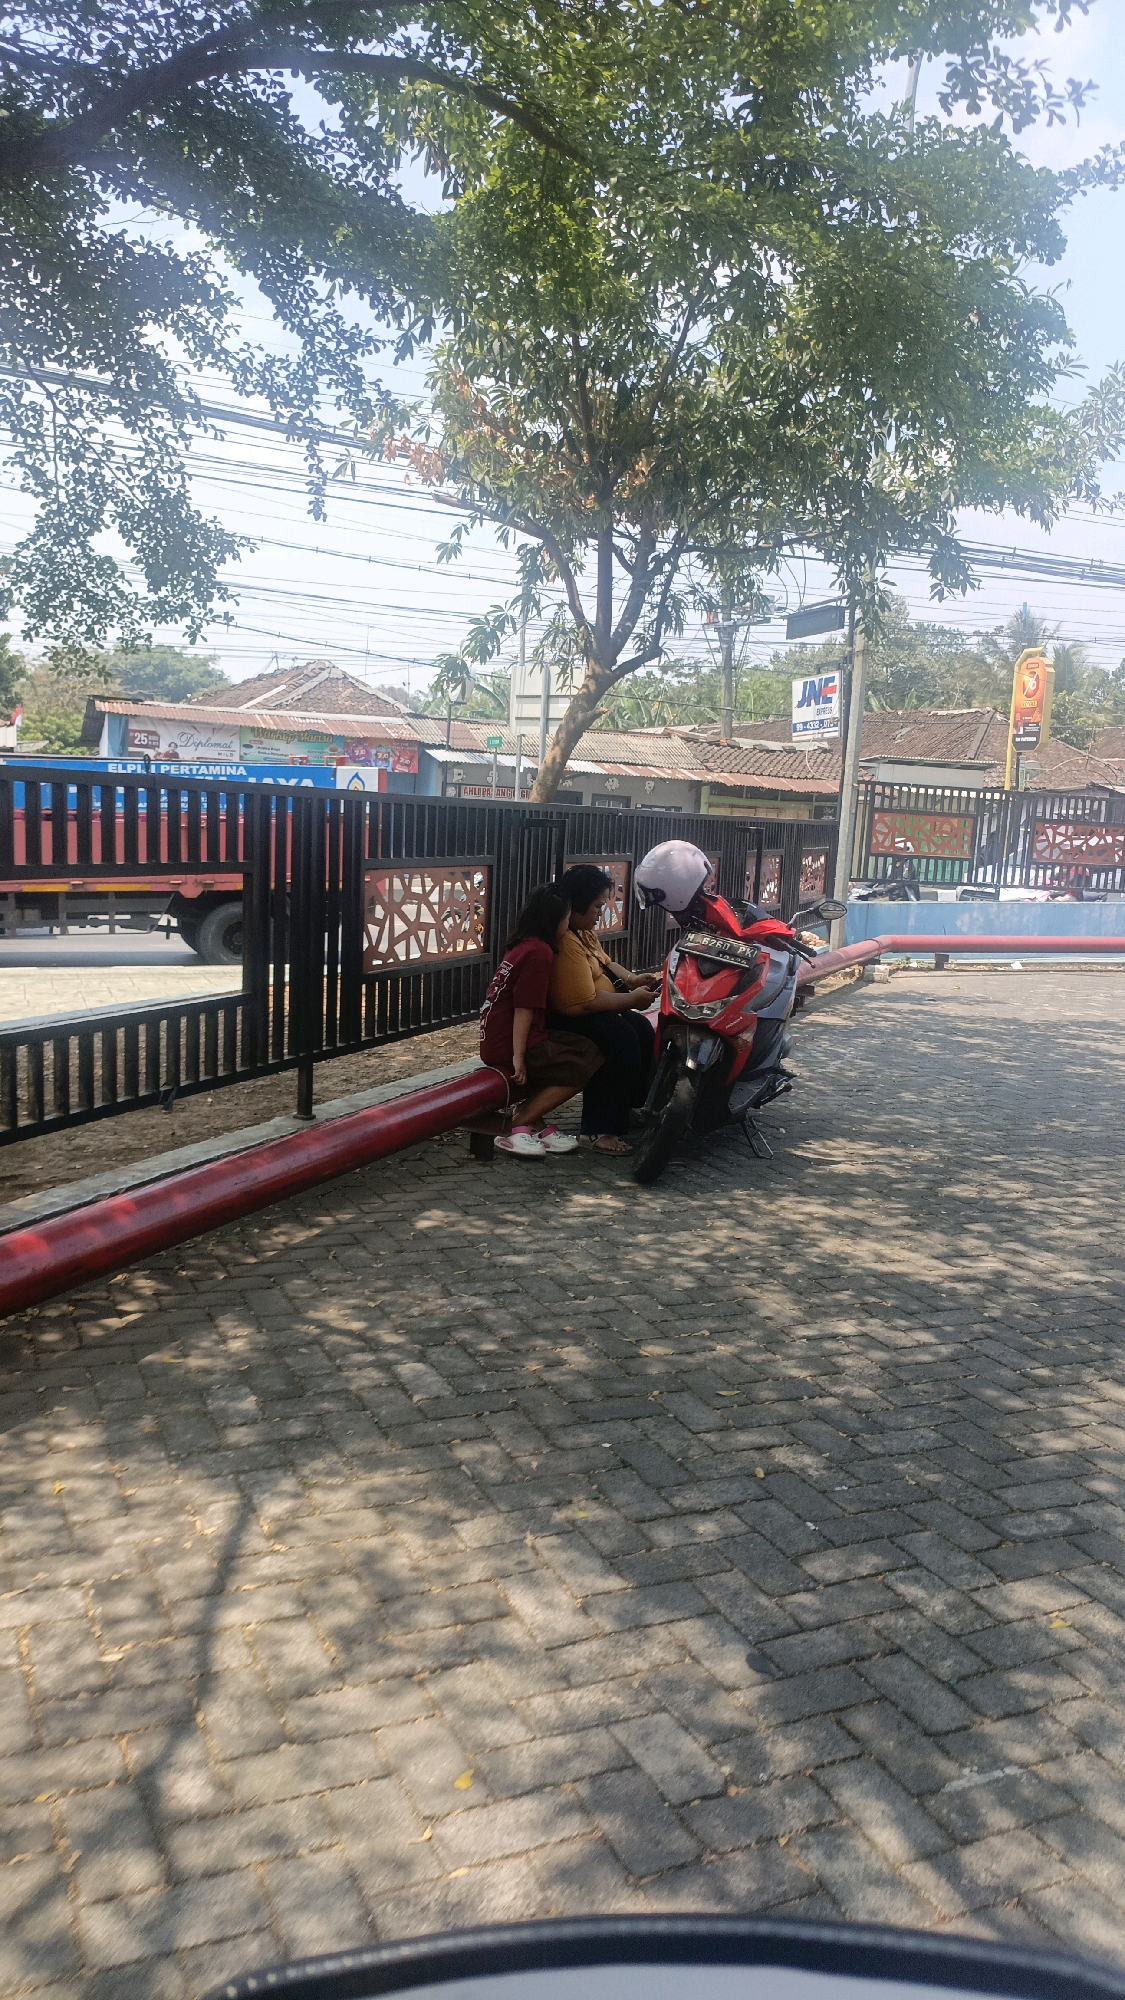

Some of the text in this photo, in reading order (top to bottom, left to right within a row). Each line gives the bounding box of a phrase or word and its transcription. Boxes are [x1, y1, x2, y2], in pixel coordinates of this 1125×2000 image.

[795, 676, 837, 709] JNE
[816, 706, 833, 716] EXPRESS
[134, 732, 148, 745] 25
[177, 731, 234, 751] Diplomat
[160, 764, 248, 776] PERTAMINA
[463, 786, 480, 796] AHLI
[482, 787, 511, 798] PAANG
